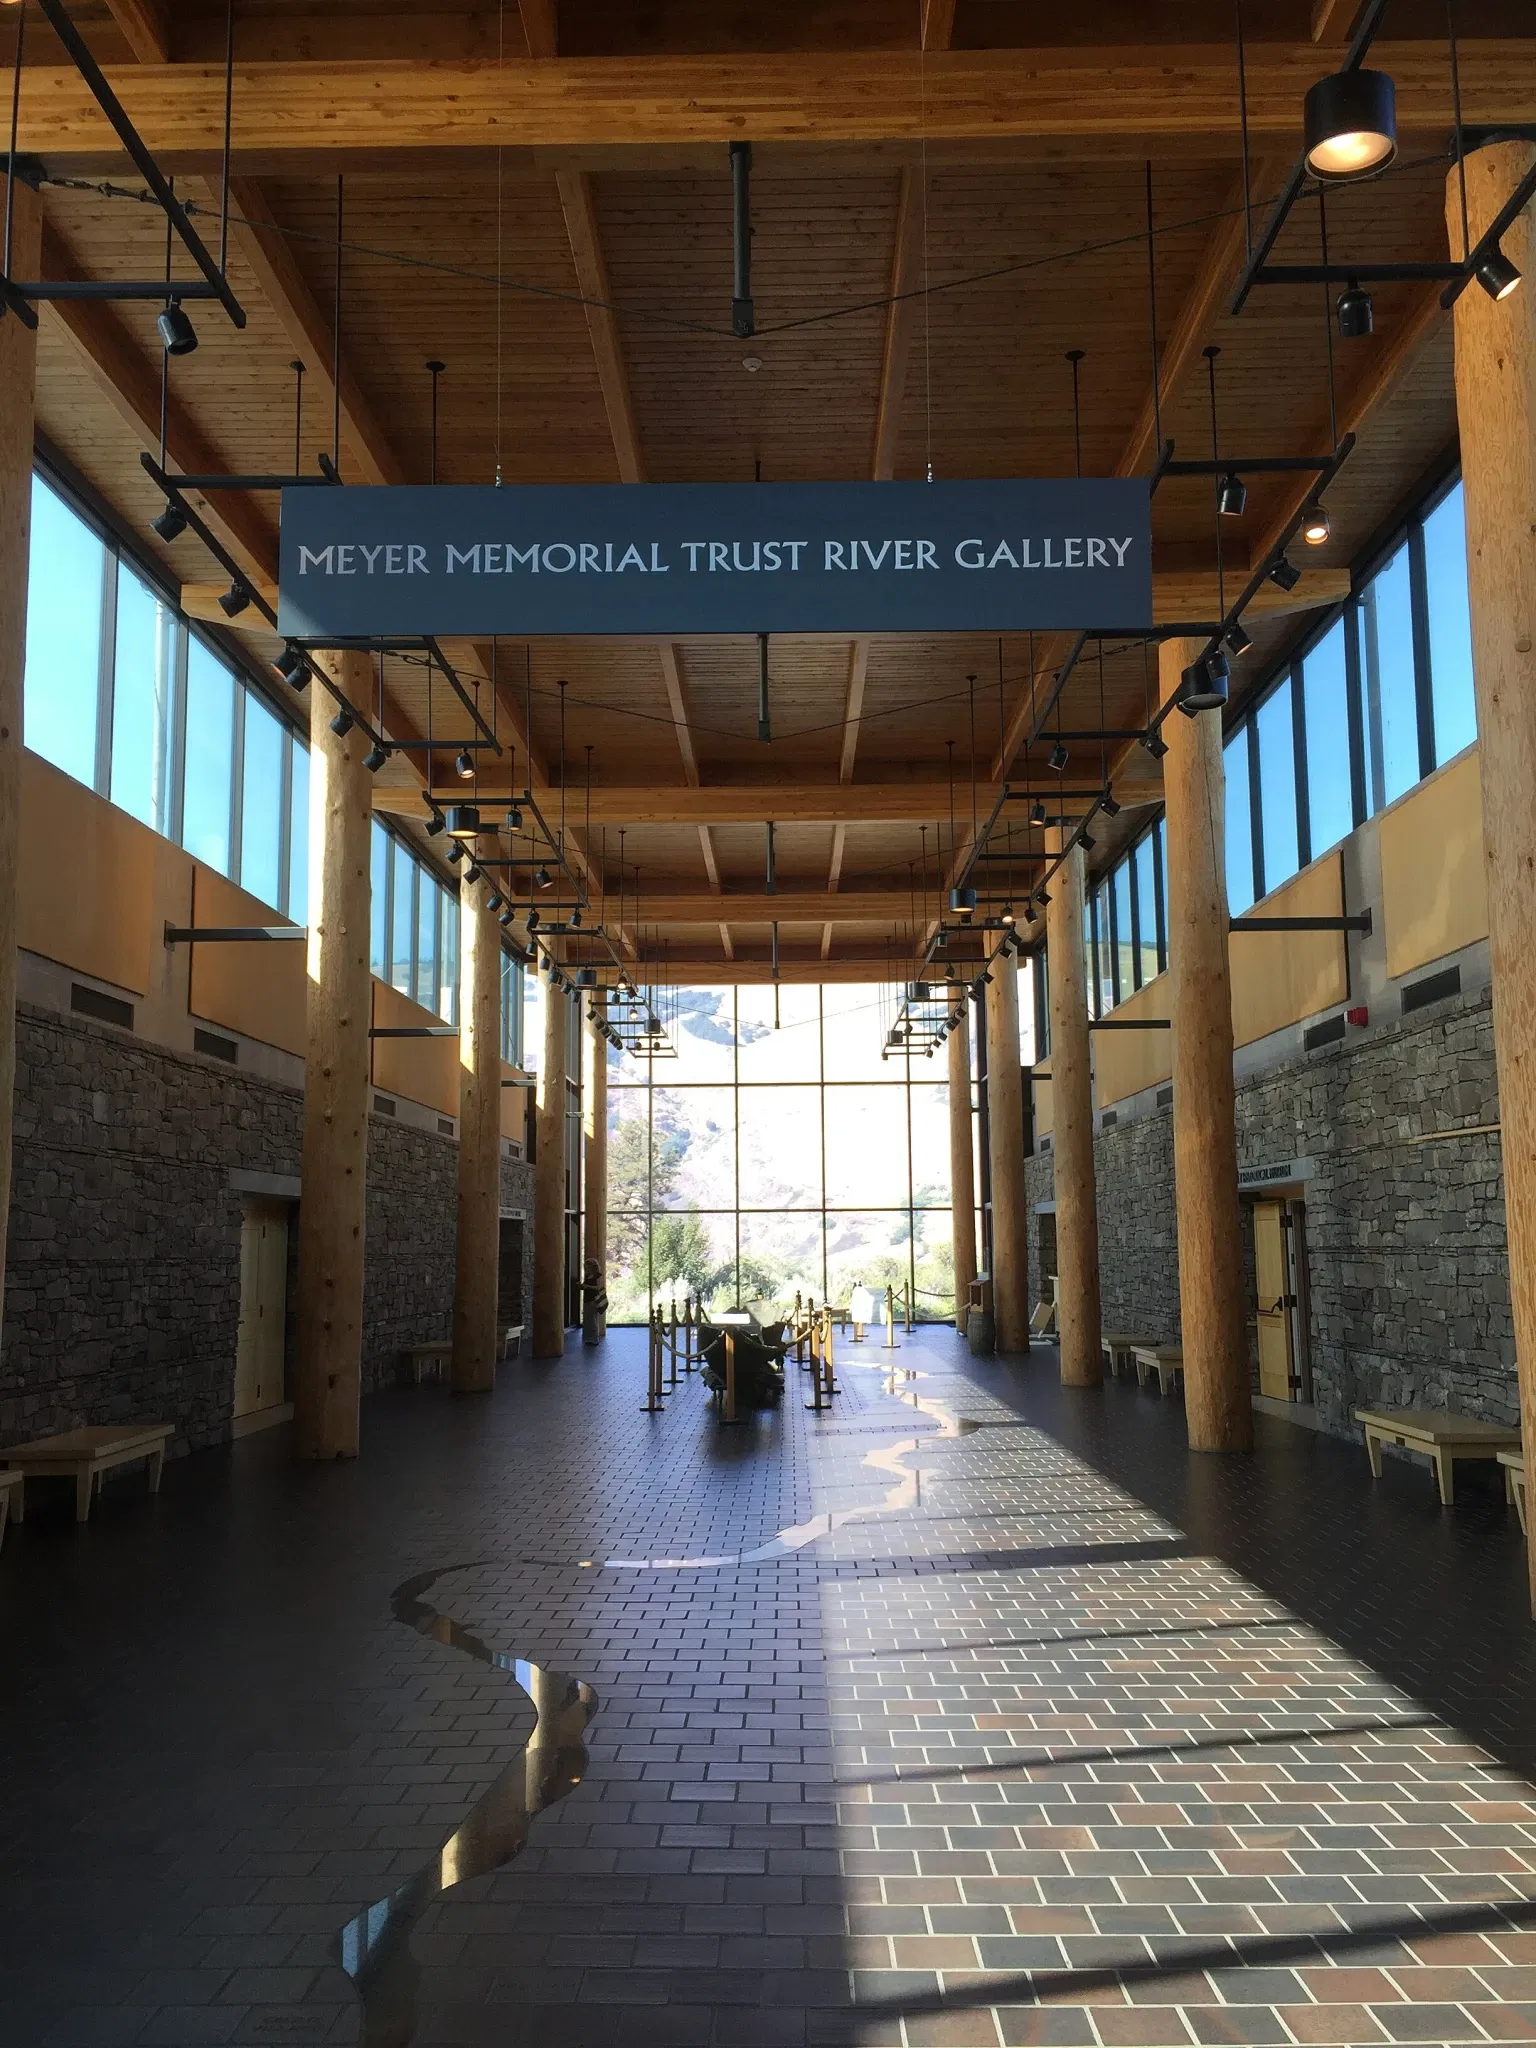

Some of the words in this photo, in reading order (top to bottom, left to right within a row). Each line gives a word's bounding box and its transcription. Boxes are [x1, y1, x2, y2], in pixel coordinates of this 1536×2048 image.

[298, 545, 431, 575] MEYER
[445, 543, 670, 573] MEMORIAL
[681, 541, 808, 571] TRUST
[823, 540, 940, 570] RIVER
[953, 537, 1133, 568] GALLERY
